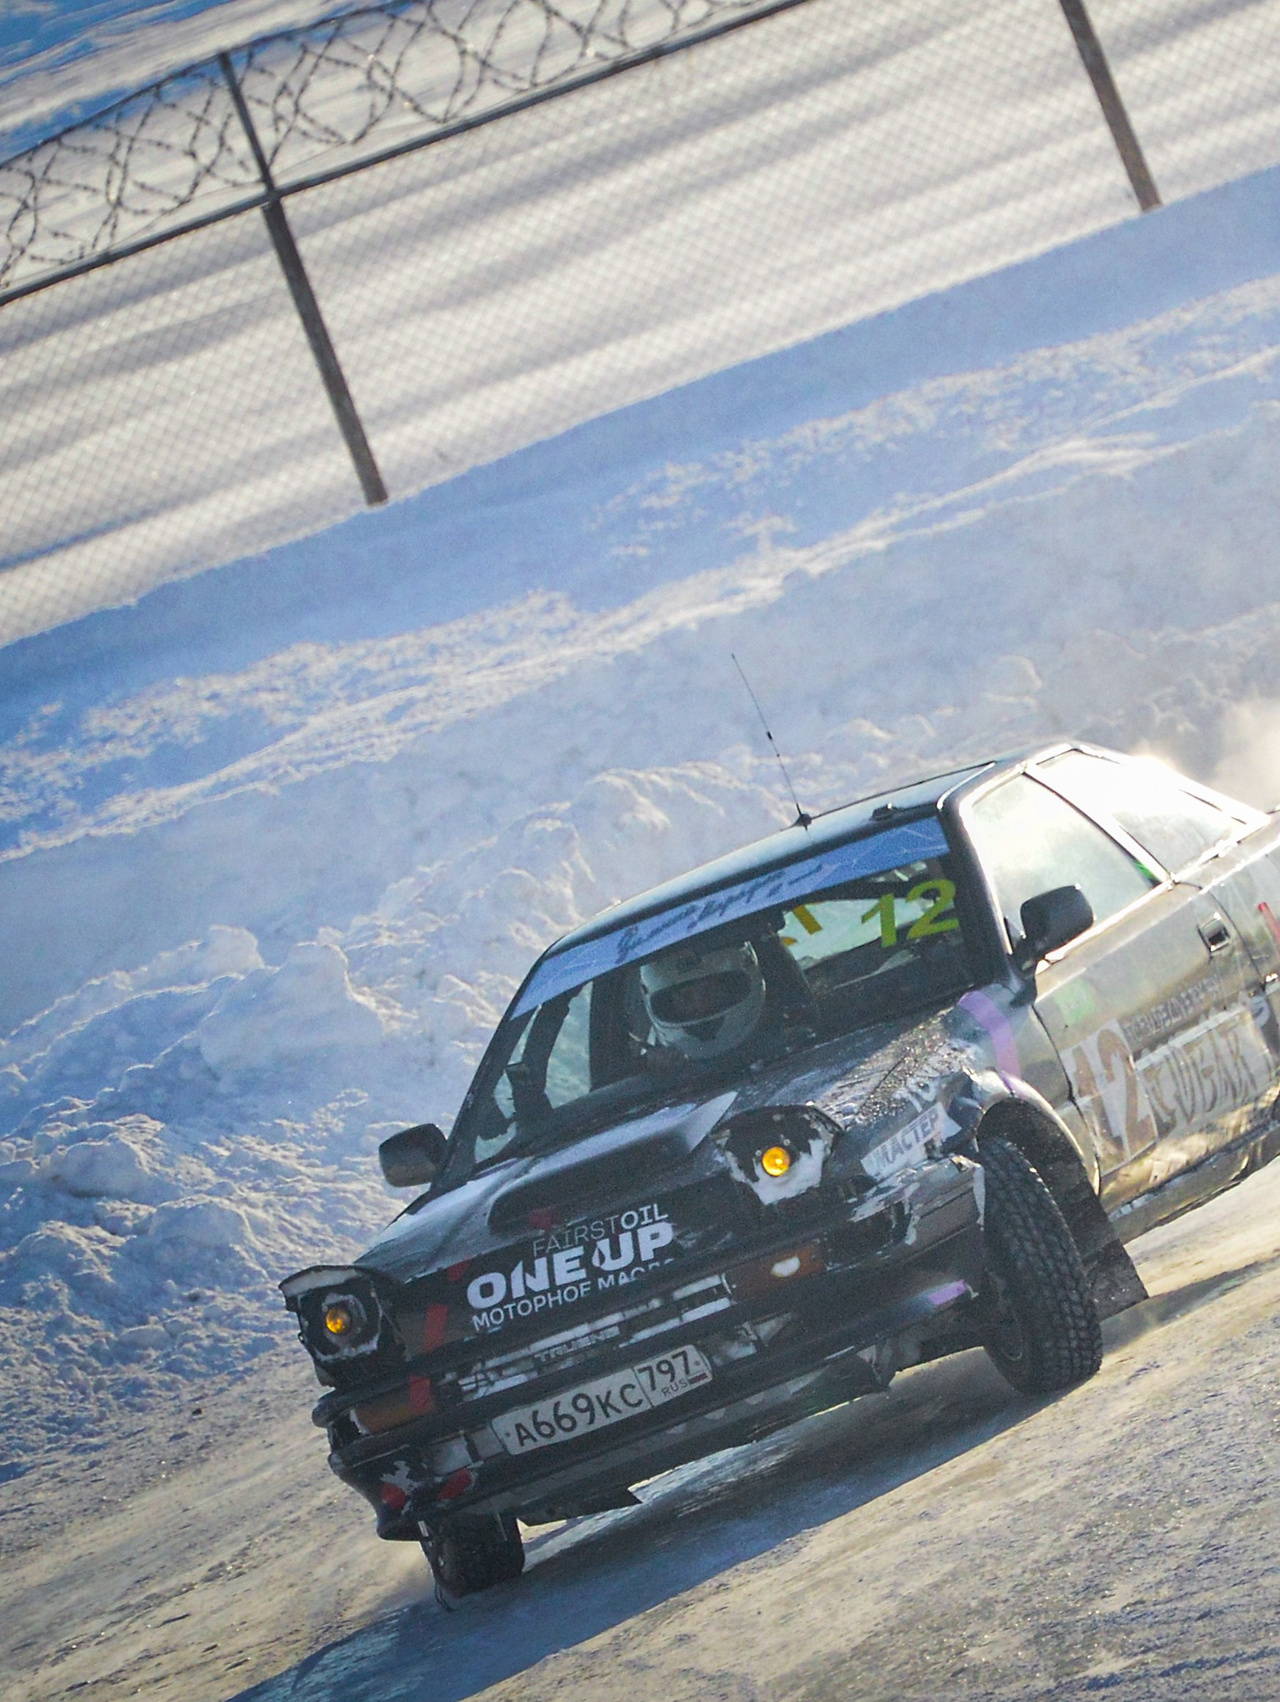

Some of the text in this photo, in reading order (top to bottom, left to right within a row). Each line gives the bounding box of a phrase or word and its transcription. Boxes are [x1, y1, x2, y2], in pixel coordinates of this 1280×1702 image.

[861, 879, 960, 949] 12
[514, 1351, 693, 1447] А669КС 797
[661, 1378, 688, 1397] RUS
